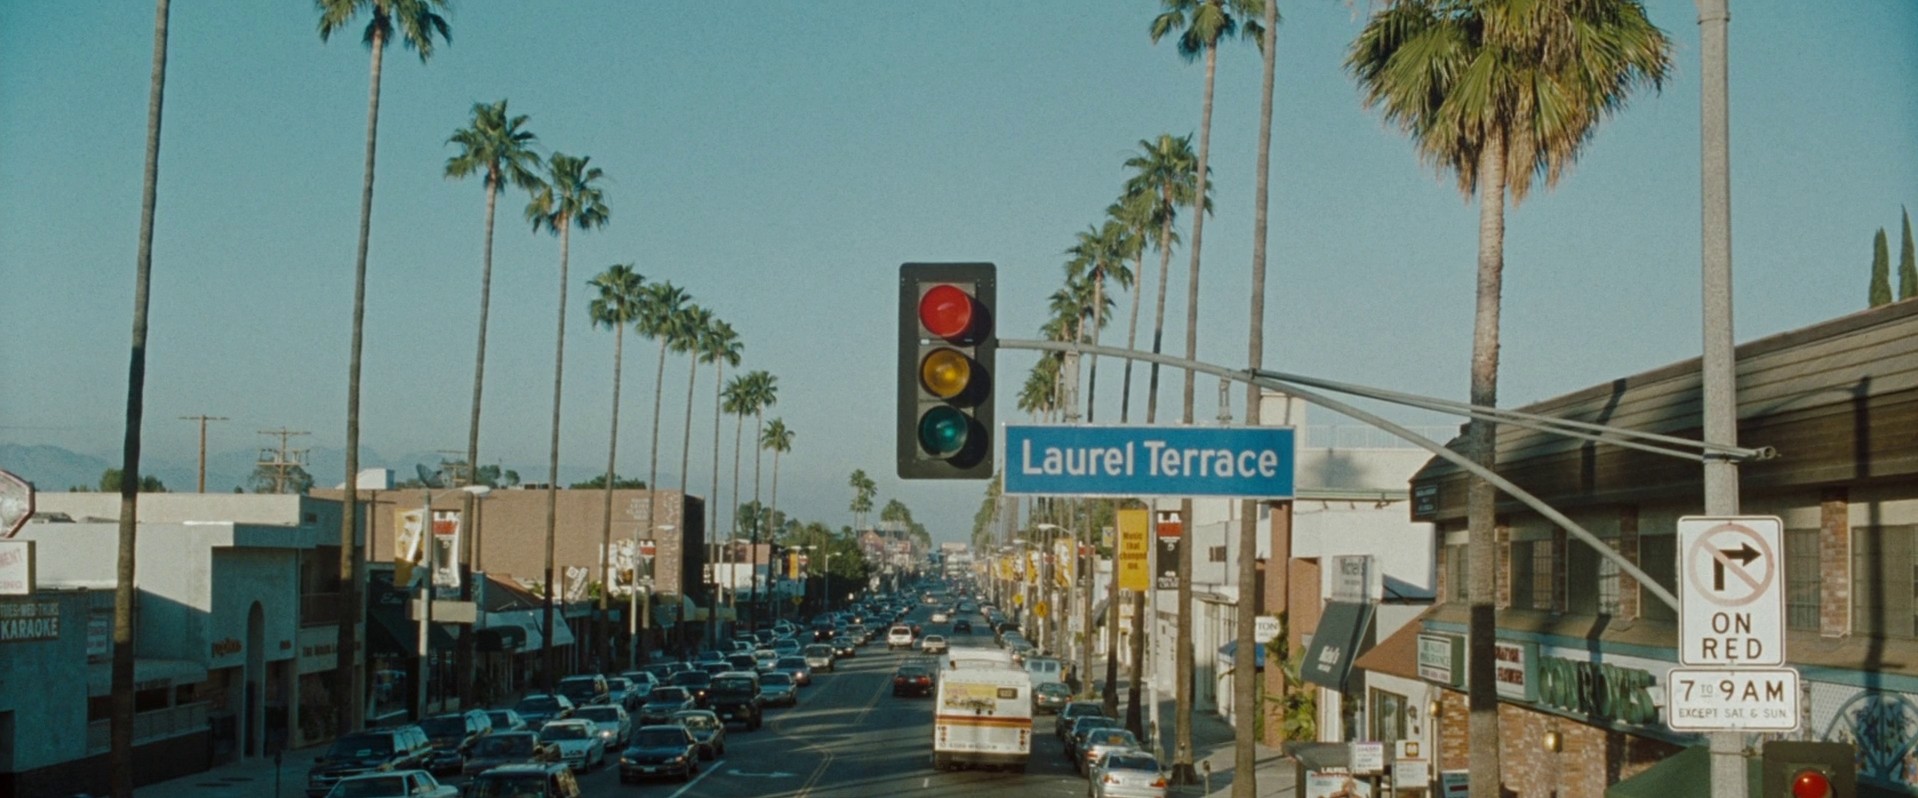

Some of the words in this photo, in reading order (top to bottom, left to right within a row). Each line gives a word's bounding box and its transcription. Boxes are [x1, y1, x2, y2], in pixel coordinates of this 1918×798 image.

[1022, 439, 1135, 476] Laurel
[1143, 440, 1278, 477] Terrace
[1, 617, 59, 639] KARAOKE
[1257, 622, 1278, 631] TON
[1711, 612, 1751, 634] ON
[1702, 637, 1762, 659] RED
[1679, 680, 1695, 702] 7
[1700, 684, 1713, 698] TO
[1678, 708, 1718, 719] EXCEPT
[1749, 709, 1758, 719] &
[1763, 709, 1787, 719] SUN
